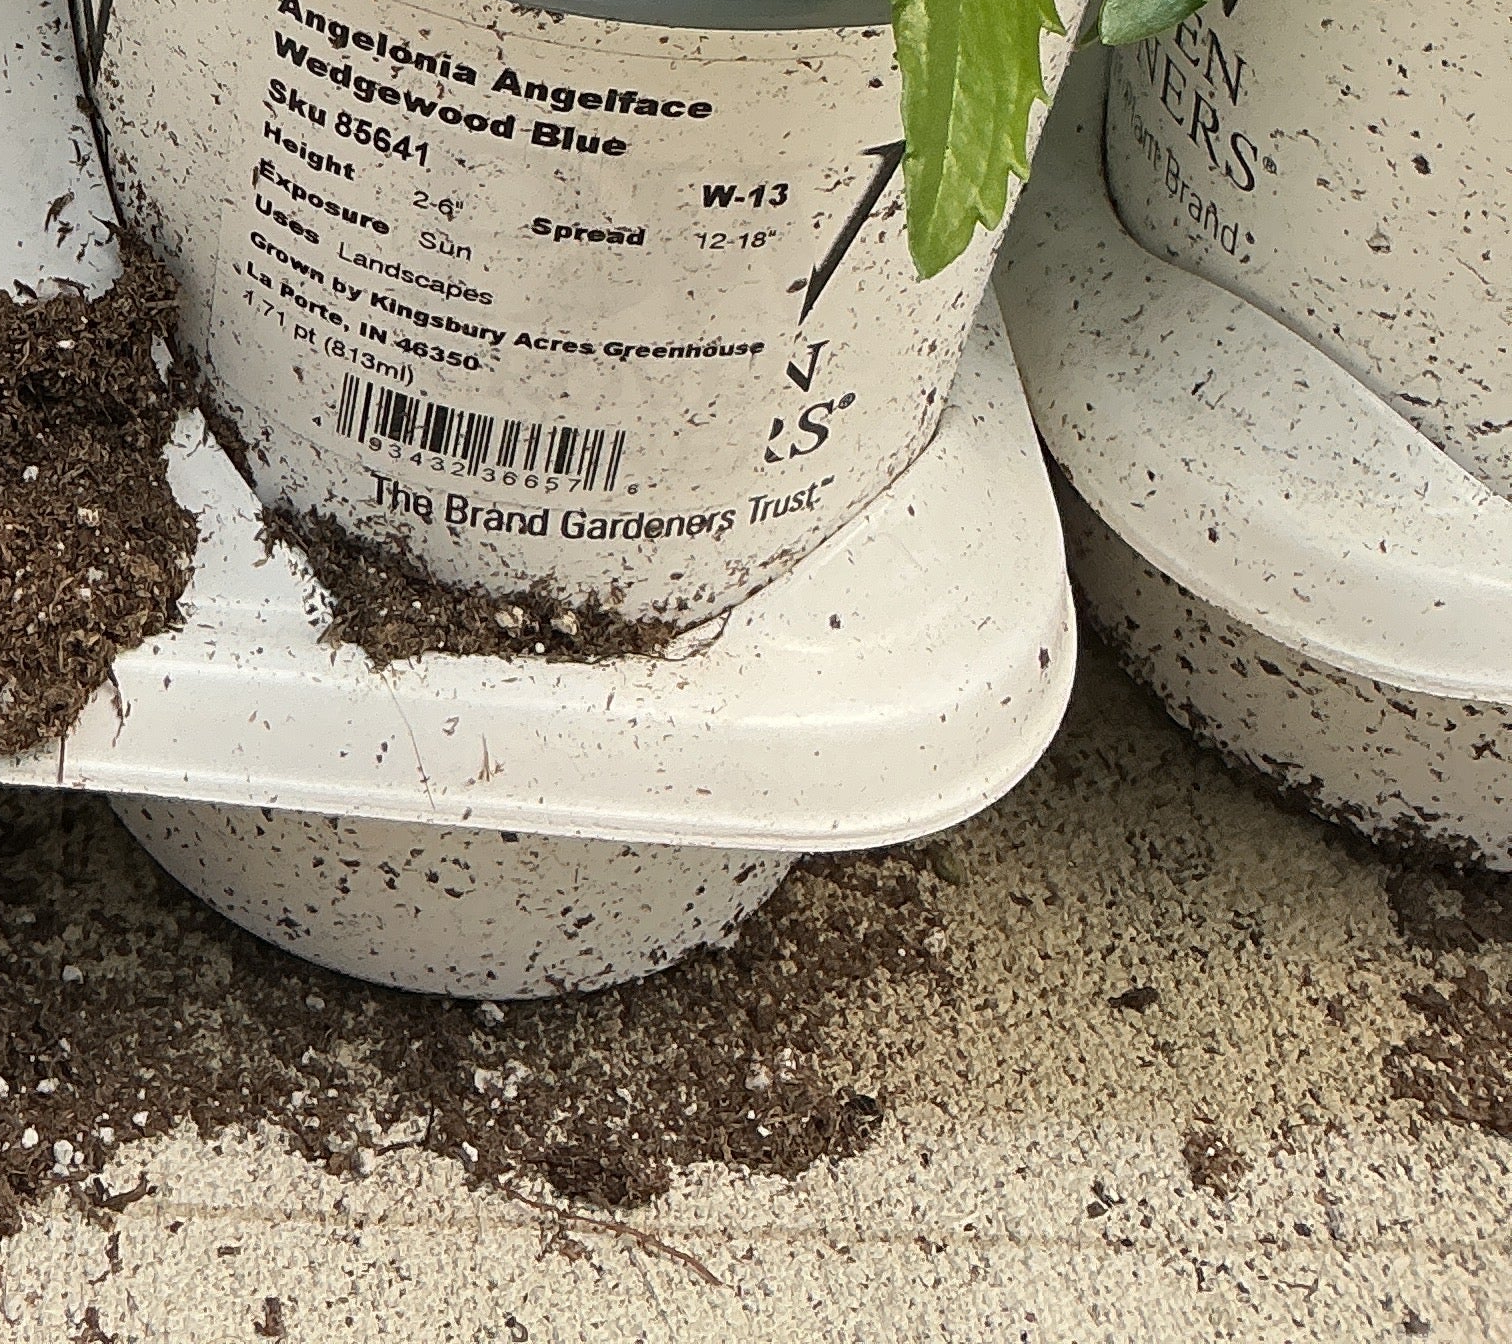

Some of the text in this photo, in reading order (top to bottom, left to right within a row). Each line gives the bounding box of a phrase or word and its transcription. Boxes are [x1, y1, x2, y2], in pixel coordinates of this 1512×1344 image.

[268, 78, 430, 168] Sku 85641
[274, 30, 628, 157] Wedgewood Blue
[490, 67, 714, 120] Angelface
[263, 120, 356, 182] Height
[258, 158, 473, 263] Exposure Sun
[530, 216, 647, 247] Spread
[701, 182, 790, 209] W-13
[1164, 148, 1239, 256] Brand
[254, 192, 495, 306] Uses Landscapes
[246, 260, 482, 372] La Porte, IN 46350
[249, 230, 766, 360] Grown by Kingsbury Acres Greenhouse
[293, 323, 318, 346] pt
[368, 436, 467, 479] 93432
[481, 466, 582, 494] 36657
[627, 482, 639, 496] 6
[370, 472, 434, 518] The
[444, 492, 550, 538] Brand
[560, 508, 737, 541] Gardeners
